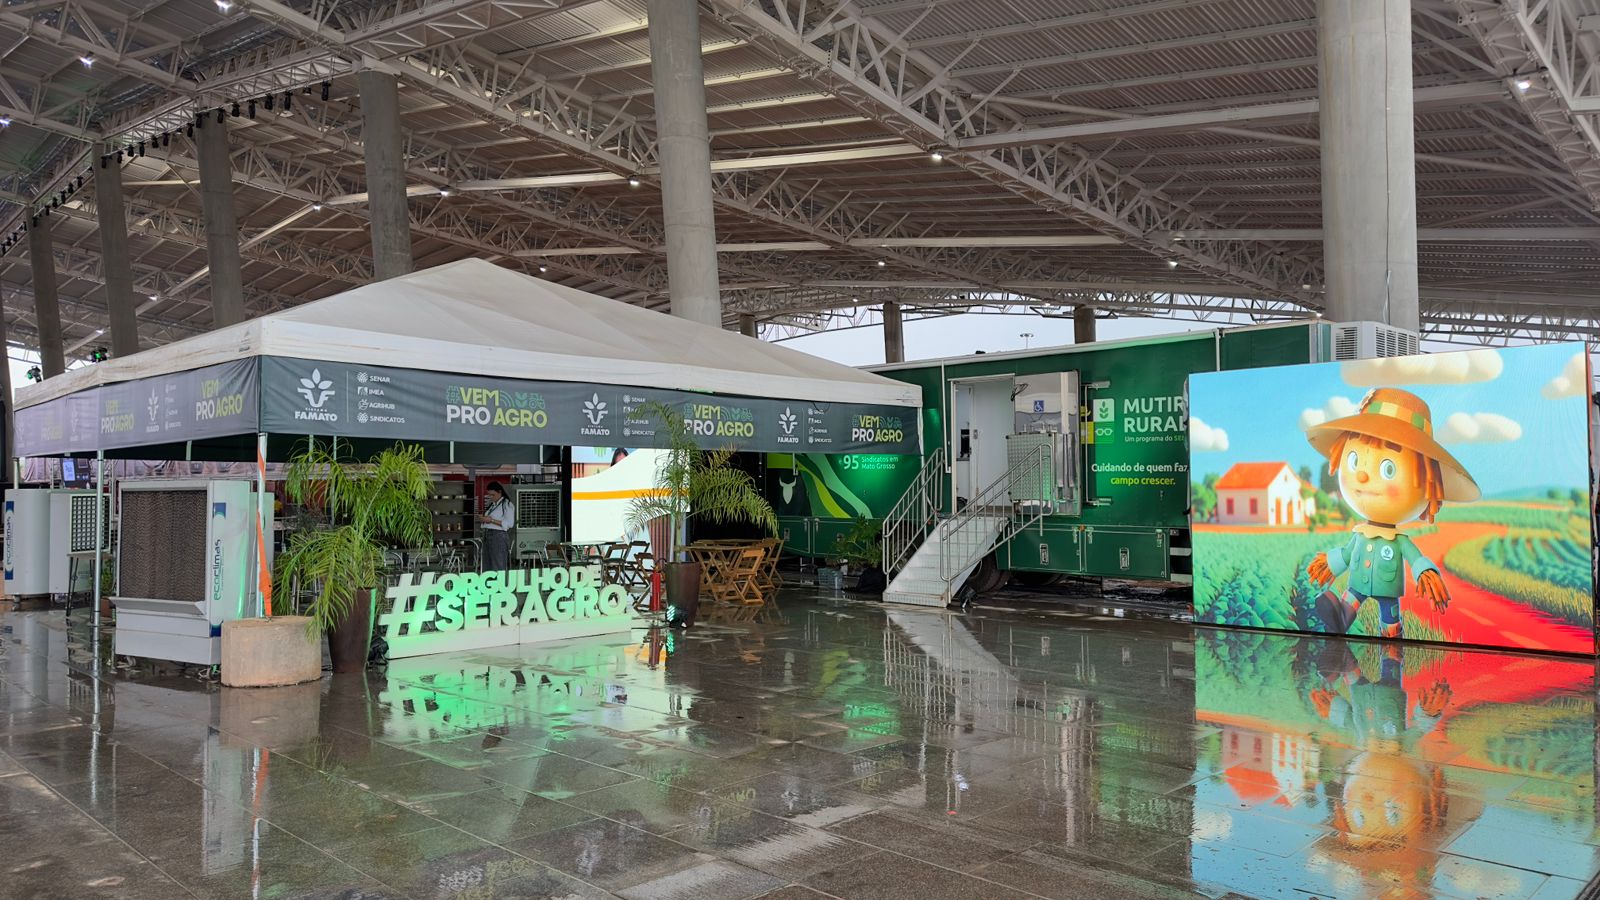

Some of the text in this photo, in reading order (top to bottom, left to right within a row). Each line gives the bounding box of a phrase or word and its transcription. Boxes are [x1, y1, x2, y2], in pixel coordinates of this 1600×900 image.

[369, 375, 391, 383] SENAR
[195, 394, 243, 421] PRO AGRO
[369, 402, 396, 410] AGRIHUB
[1123, 396, 1184, 414] MUTIR
[294, 411, 338, 422] FAMATO
[369, 415, 405, 424] SINDICATOS
[446, 404, 548, 428] PRO AGRO
[100, 417, 114, 434] PRO
[683, 419, 754, 438] PRO AGRO
[1123, 415, 1185, 433] RURAL
[580, 428, 610, 436] FAMATO
[852, 428, 903, 443] PRO AGRO
[843, 455, 859, 470] 95
[1091, 462, 1132, 472] Cuidando
[1133, 462, 1145, 472] de
[1146, 464, 1172, 474] quem
[1110, 477, 1176, 486] campo crescer.
[213, 539, 221, 601] ecoclimas
